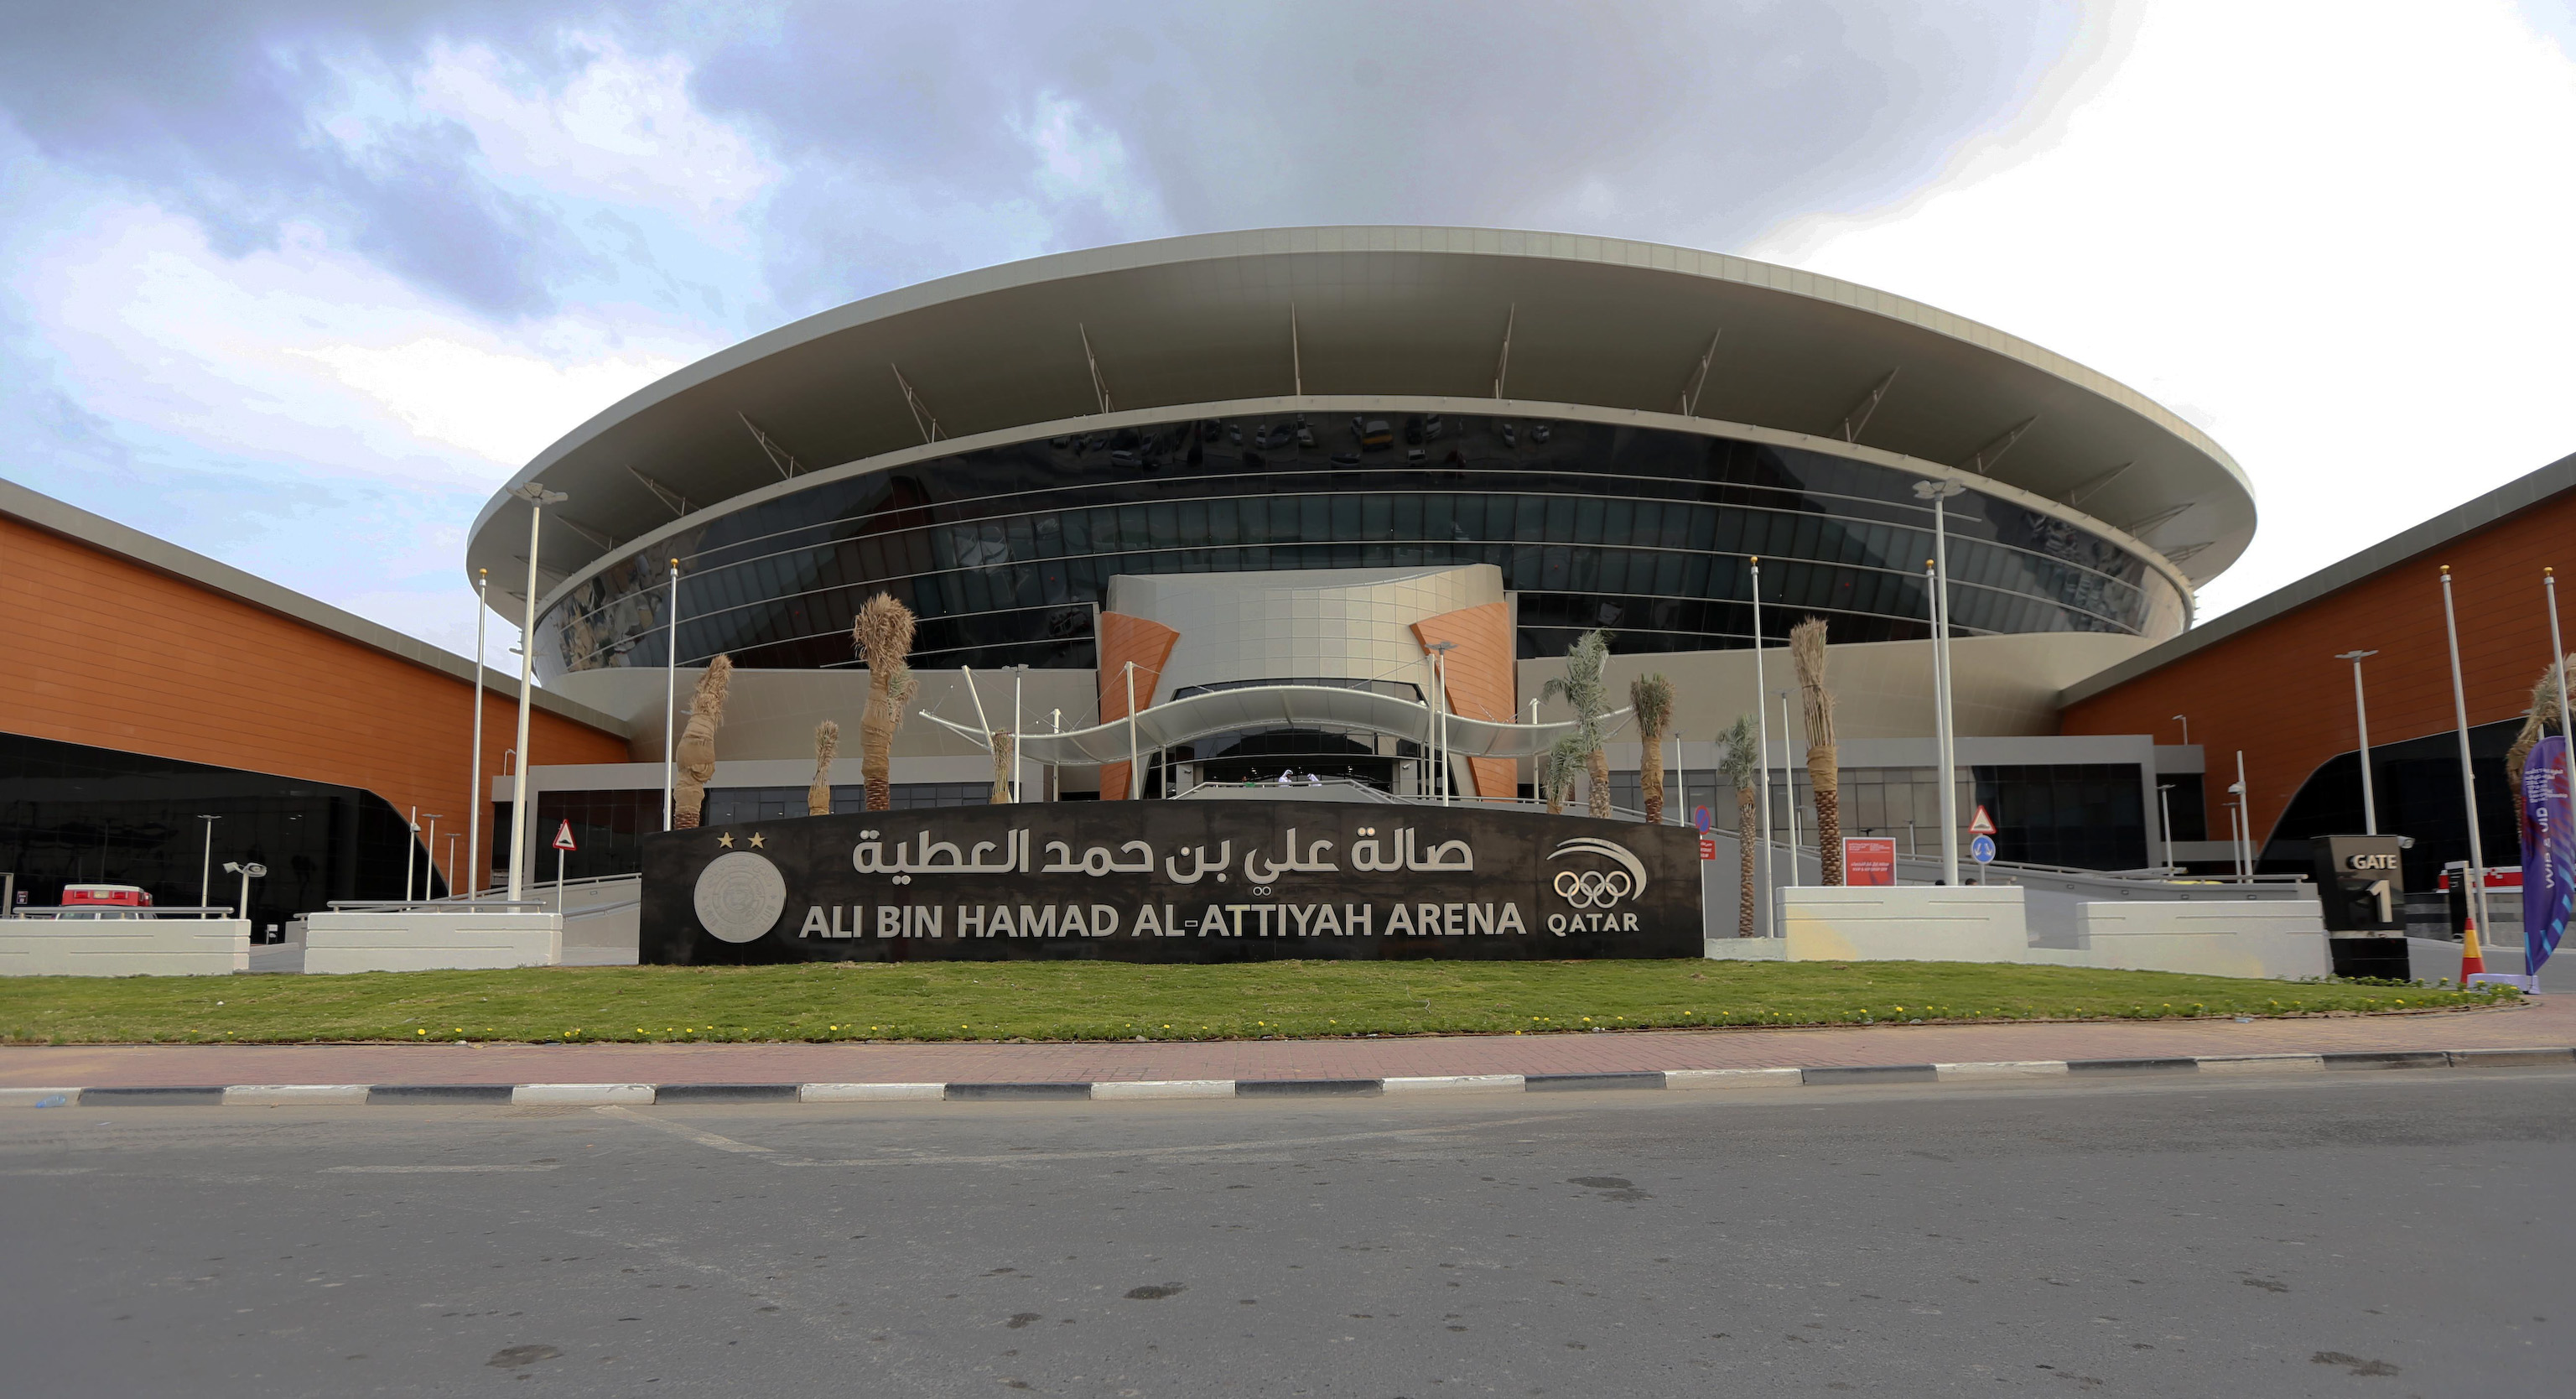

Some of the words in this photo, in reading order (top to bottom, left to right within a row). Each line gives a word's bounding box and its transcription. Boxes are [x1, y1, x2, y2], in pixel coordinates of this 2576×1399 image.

[852, 828, 1030, 886] العطية
[1041, 840, 1155, 877] حمد
[1166, 840, 1231, 885] بن
[1244, 827, 1340, 897] علي
[1351, 827, 1473, 872] صالة
[2352, 854, 2397, 870] GATE
[799, 905, 863, 938] ALI
[877, 905, 943, 938] BIN
[958, 904, 1119, 938] HAMAD
[1131, 903, 1372, 938] AL-ATTIYAH
[1384, 902, 1527, 936] ARENA
[2366, 879, 2392, 923] 1
[1547, 913, 1640, 937] QATAR
